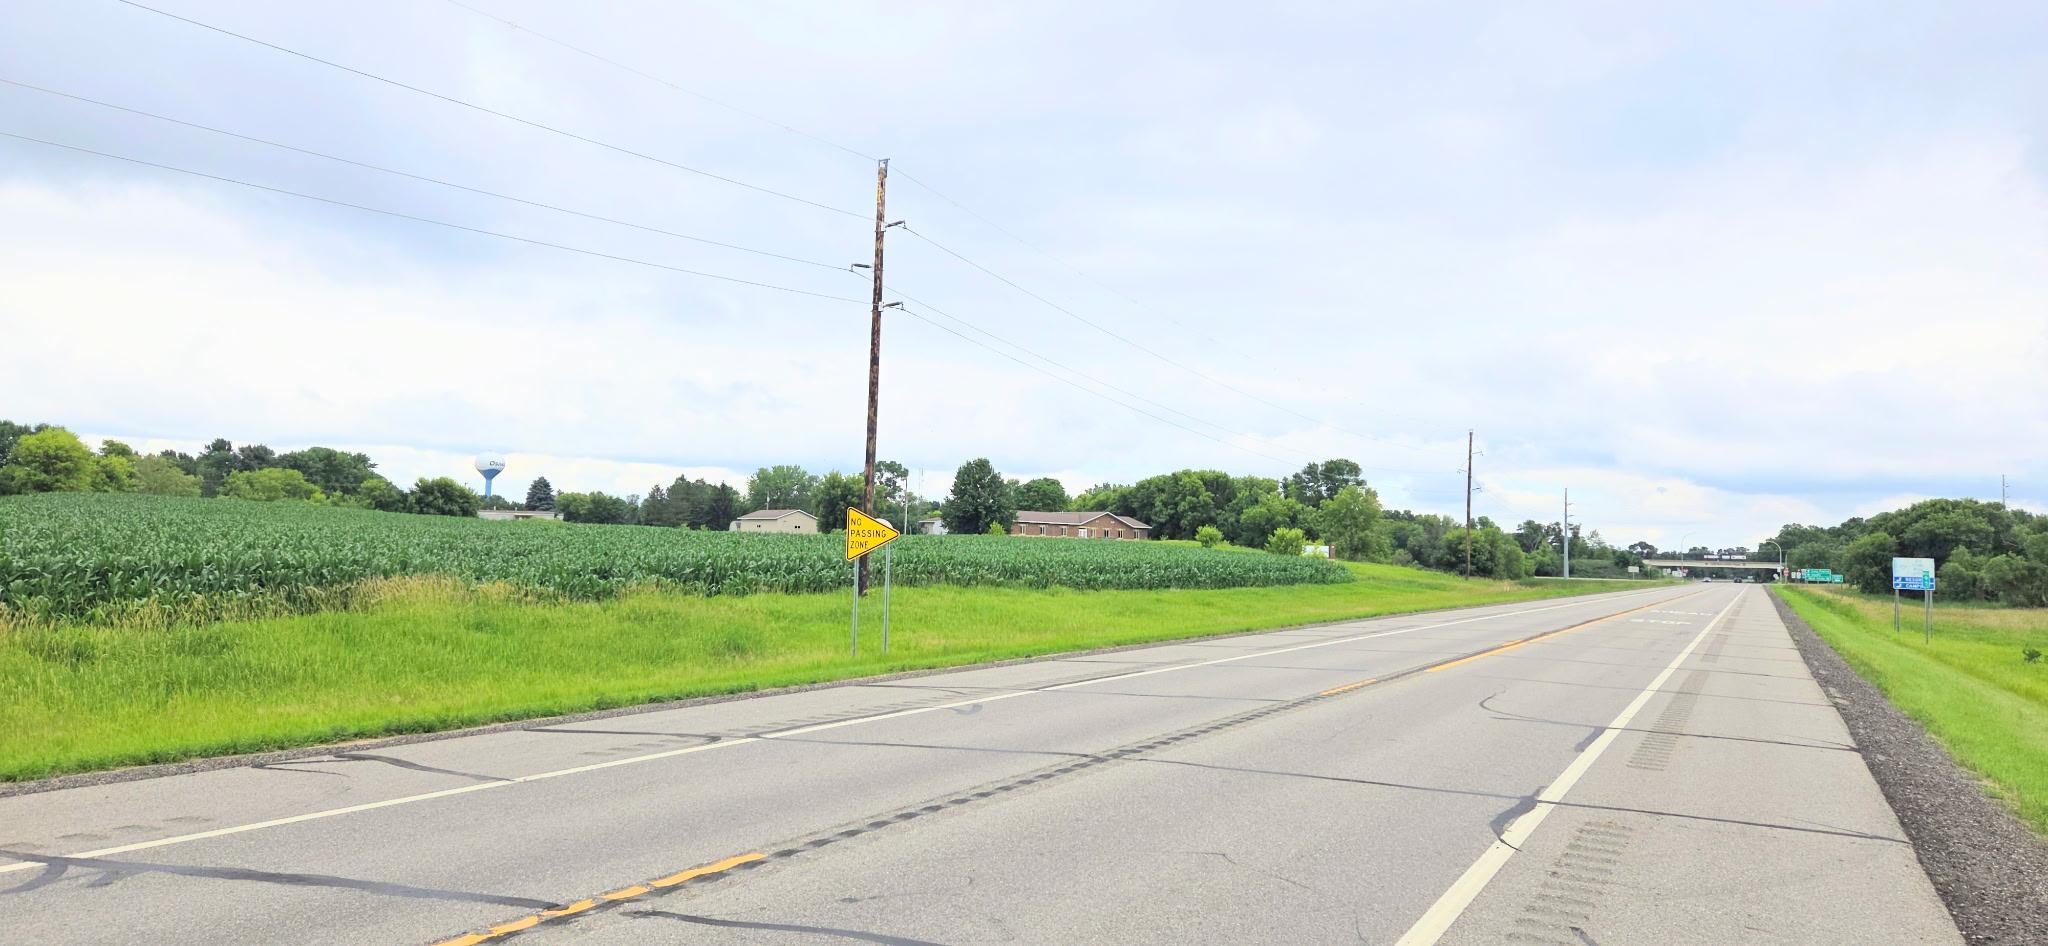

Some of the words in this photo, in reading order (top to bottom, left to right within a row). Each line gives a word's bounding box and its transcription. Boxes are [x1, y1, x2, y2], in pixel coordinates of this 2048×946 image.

[851, 518, 862, 526] NO
[850, 529, 887, 538] PASSING
[850, 540, 869, 549] ZONE
